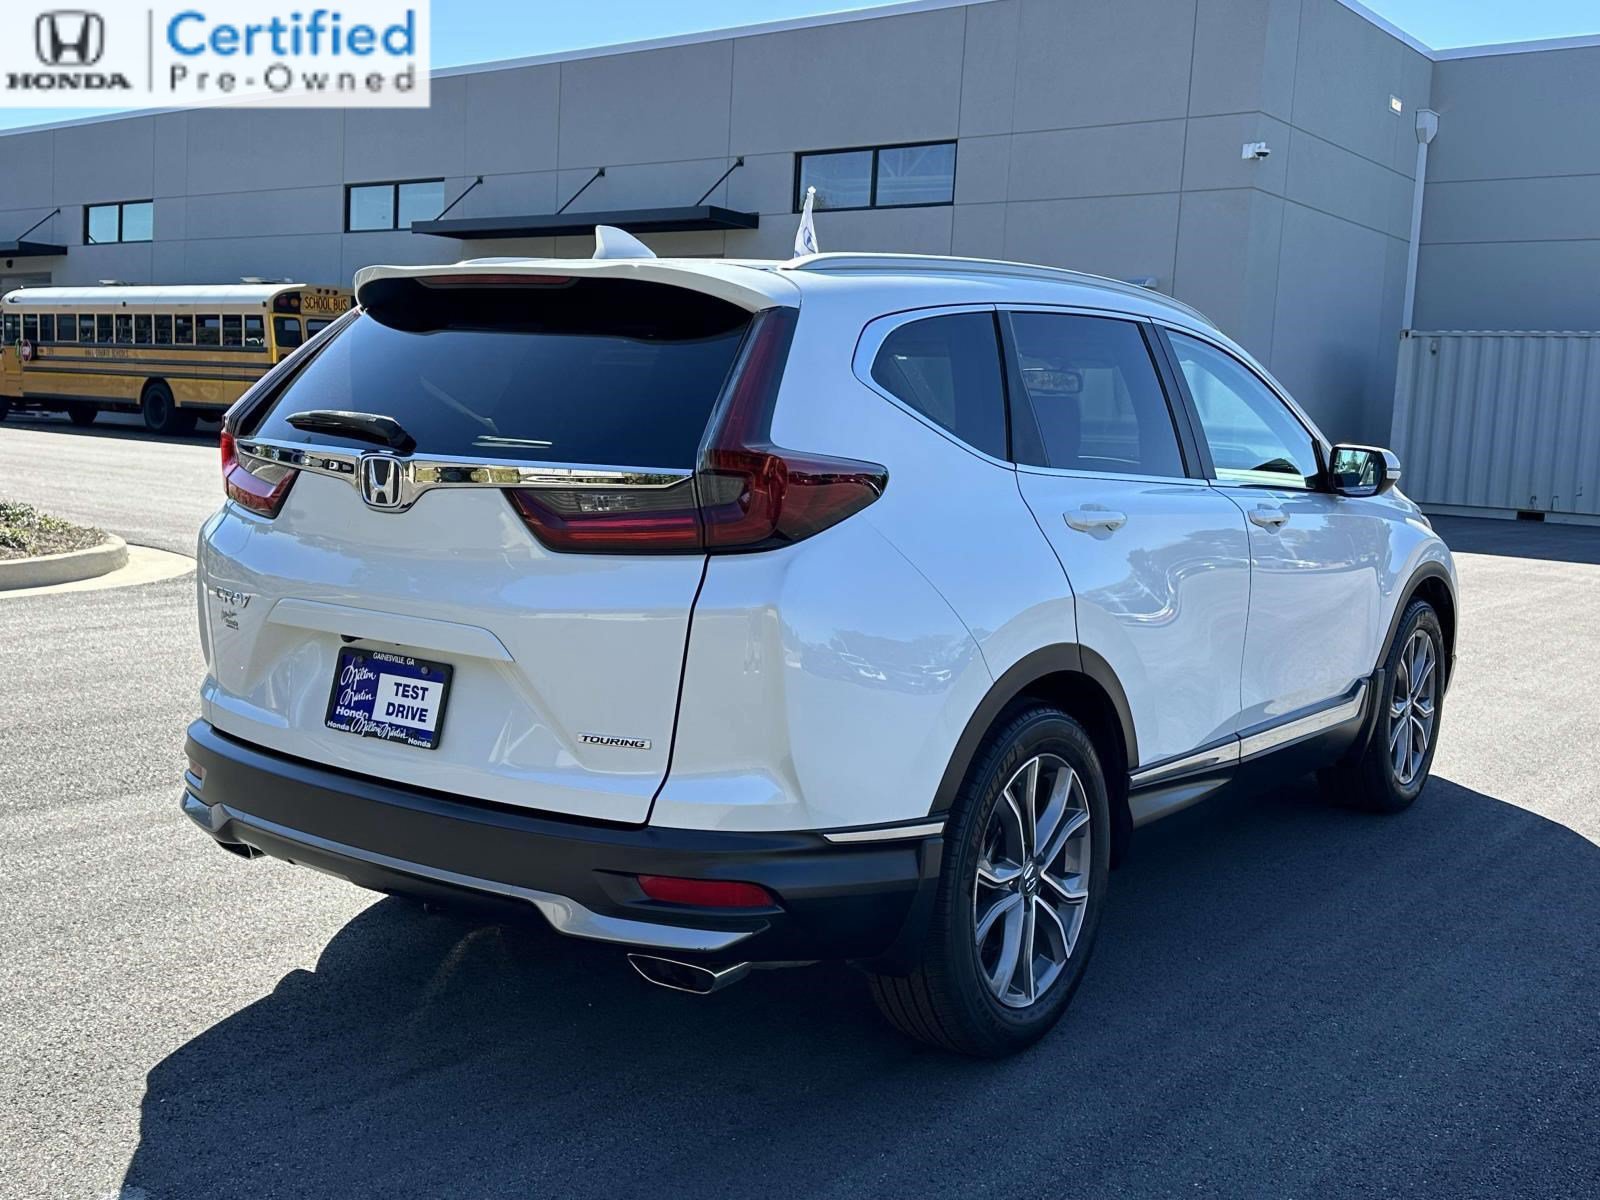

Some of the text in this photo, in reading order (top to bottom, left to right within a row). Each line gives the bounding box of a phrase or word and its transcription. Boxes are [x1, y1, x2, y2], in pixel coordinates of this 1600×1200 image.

[304, 296, 347, 311] SCHOOL BUS
[406, 658, 415, 666] GA
[341, 658, 377, 690] Milton
[394, 682, 429, 701] TEST
[336, 706, 369, 719] Honda
[386, 702, 429, 723] DRIVE
[327, 721, 350, 731] Honda
[408, 738, 431, 748] Honda
[582, 735, 645, 748] TOURING
